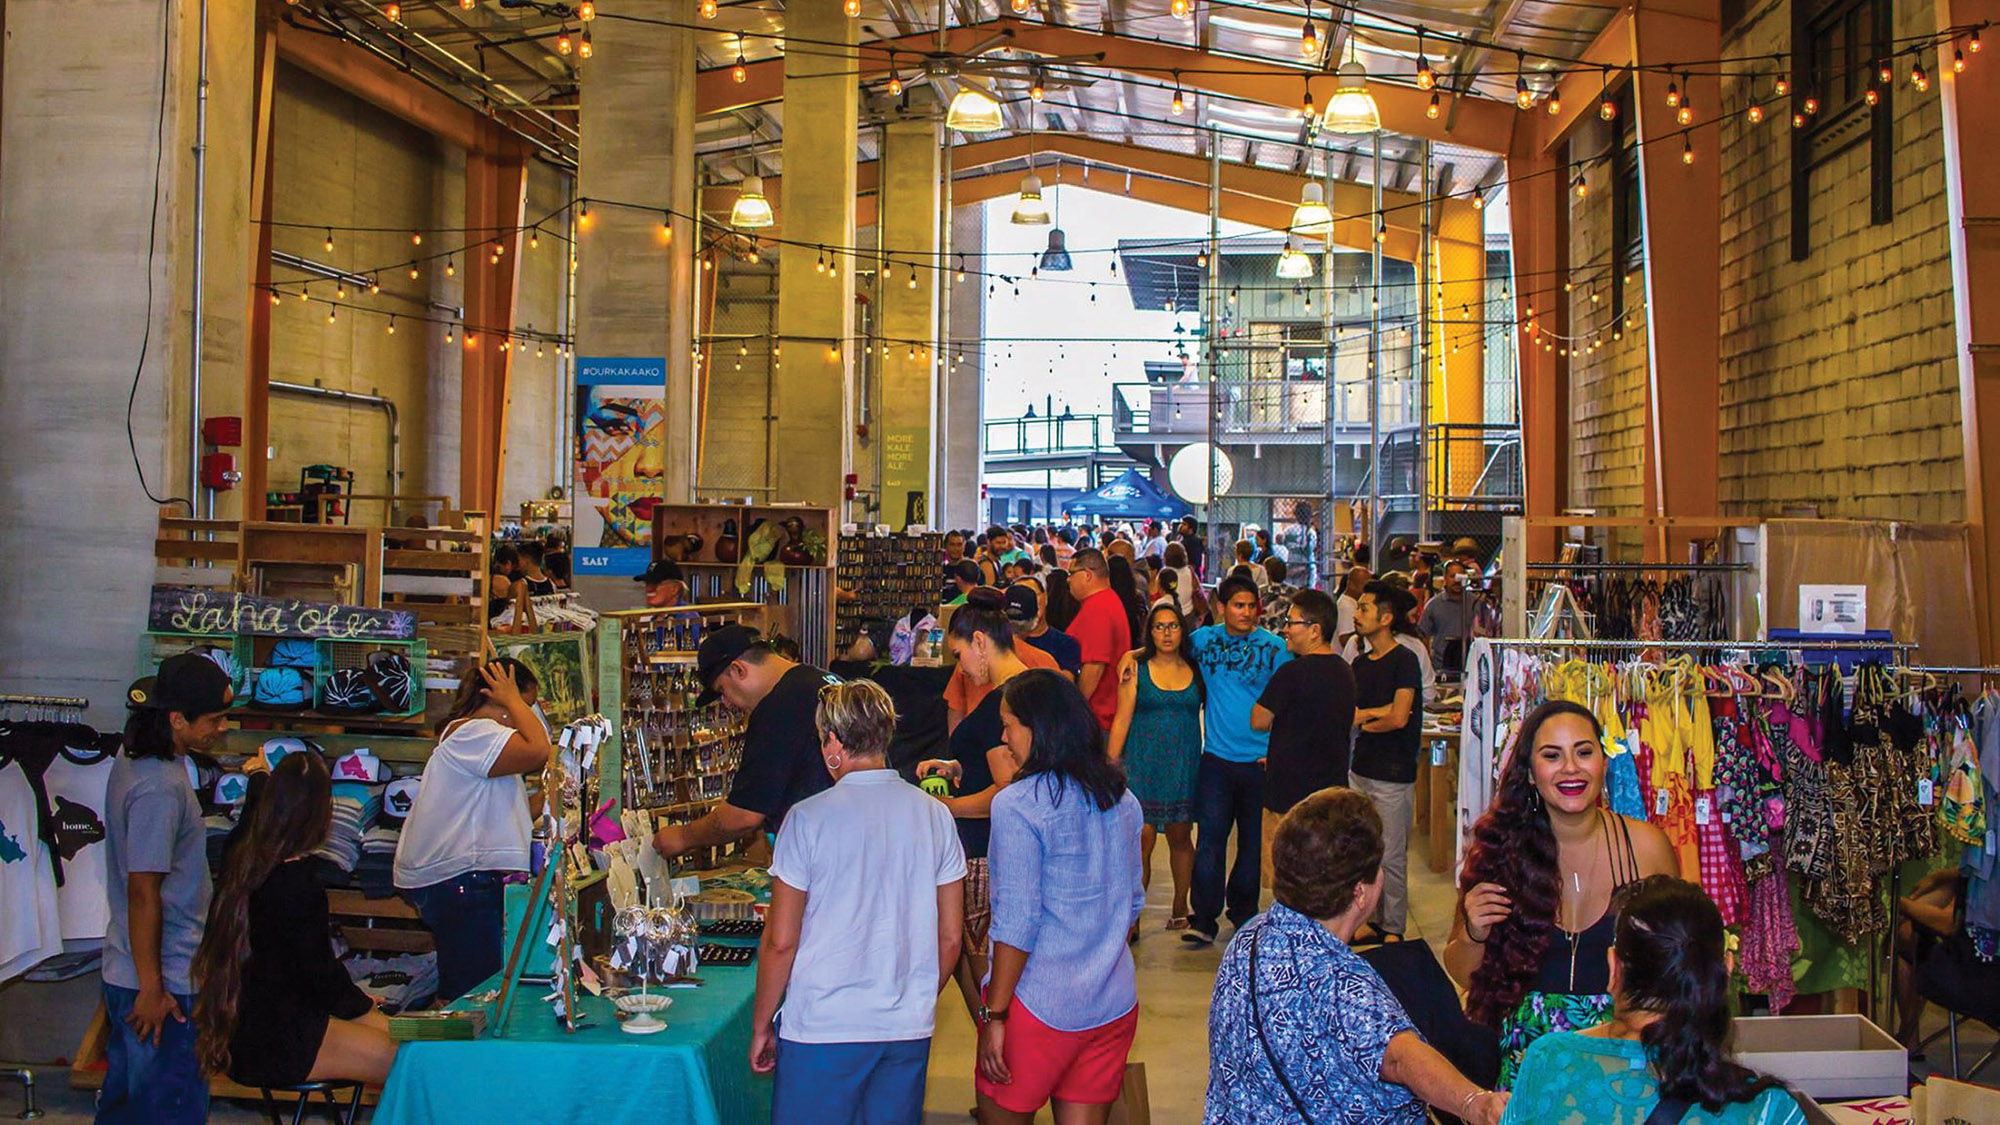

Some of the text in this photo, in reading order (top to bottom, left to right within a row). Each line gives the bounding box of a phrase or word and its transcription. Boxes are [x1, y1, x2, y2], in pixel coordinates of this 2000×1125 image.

[583, 367, 659, 376] #OURKAKAAKO
[887, 434, 914, 443] MORE
[887, 453, 913, 461] MORE
[582, 557, 609, 566] SALT
[1202, 643, 1252, 672] Hurley
[62, 821, 93, 831] home.
